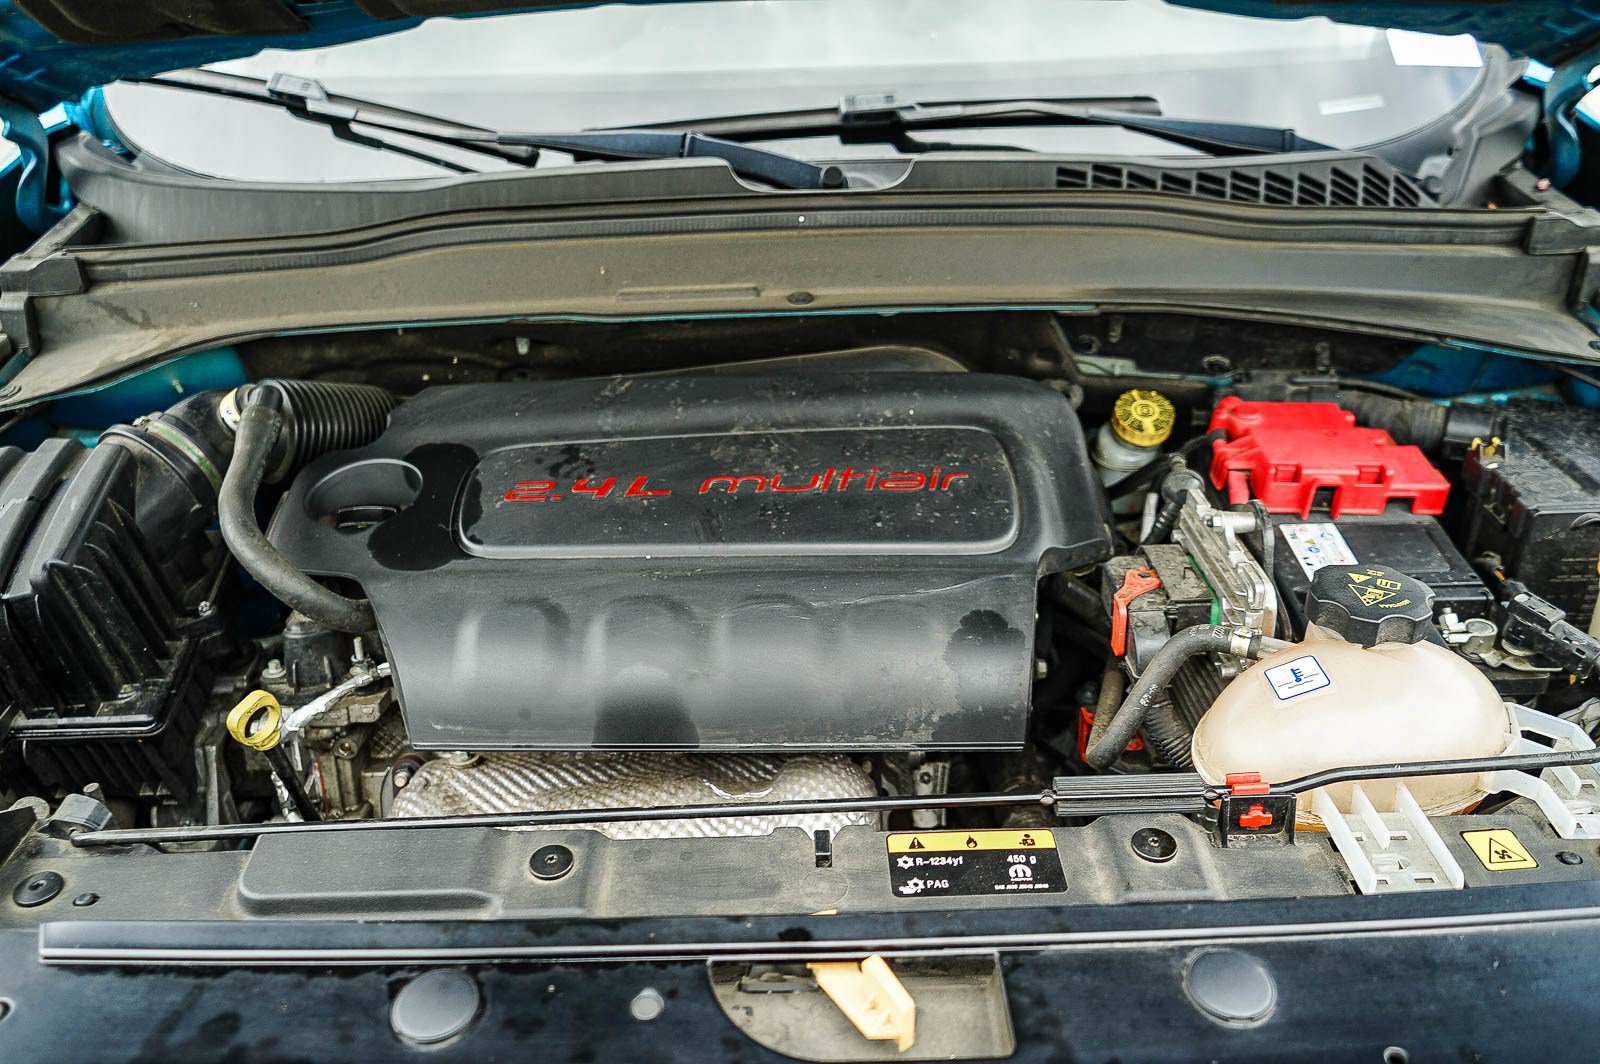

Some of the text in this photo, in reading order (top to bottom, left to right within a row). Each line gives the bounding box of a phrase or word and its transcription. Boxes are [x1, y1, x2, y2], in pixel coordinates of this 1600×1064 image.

[503, 466, 969, 502] 2.4L multiair
[1006, 854, 1037, 865] 450 g
[926, 879, 949, 889] PAG
